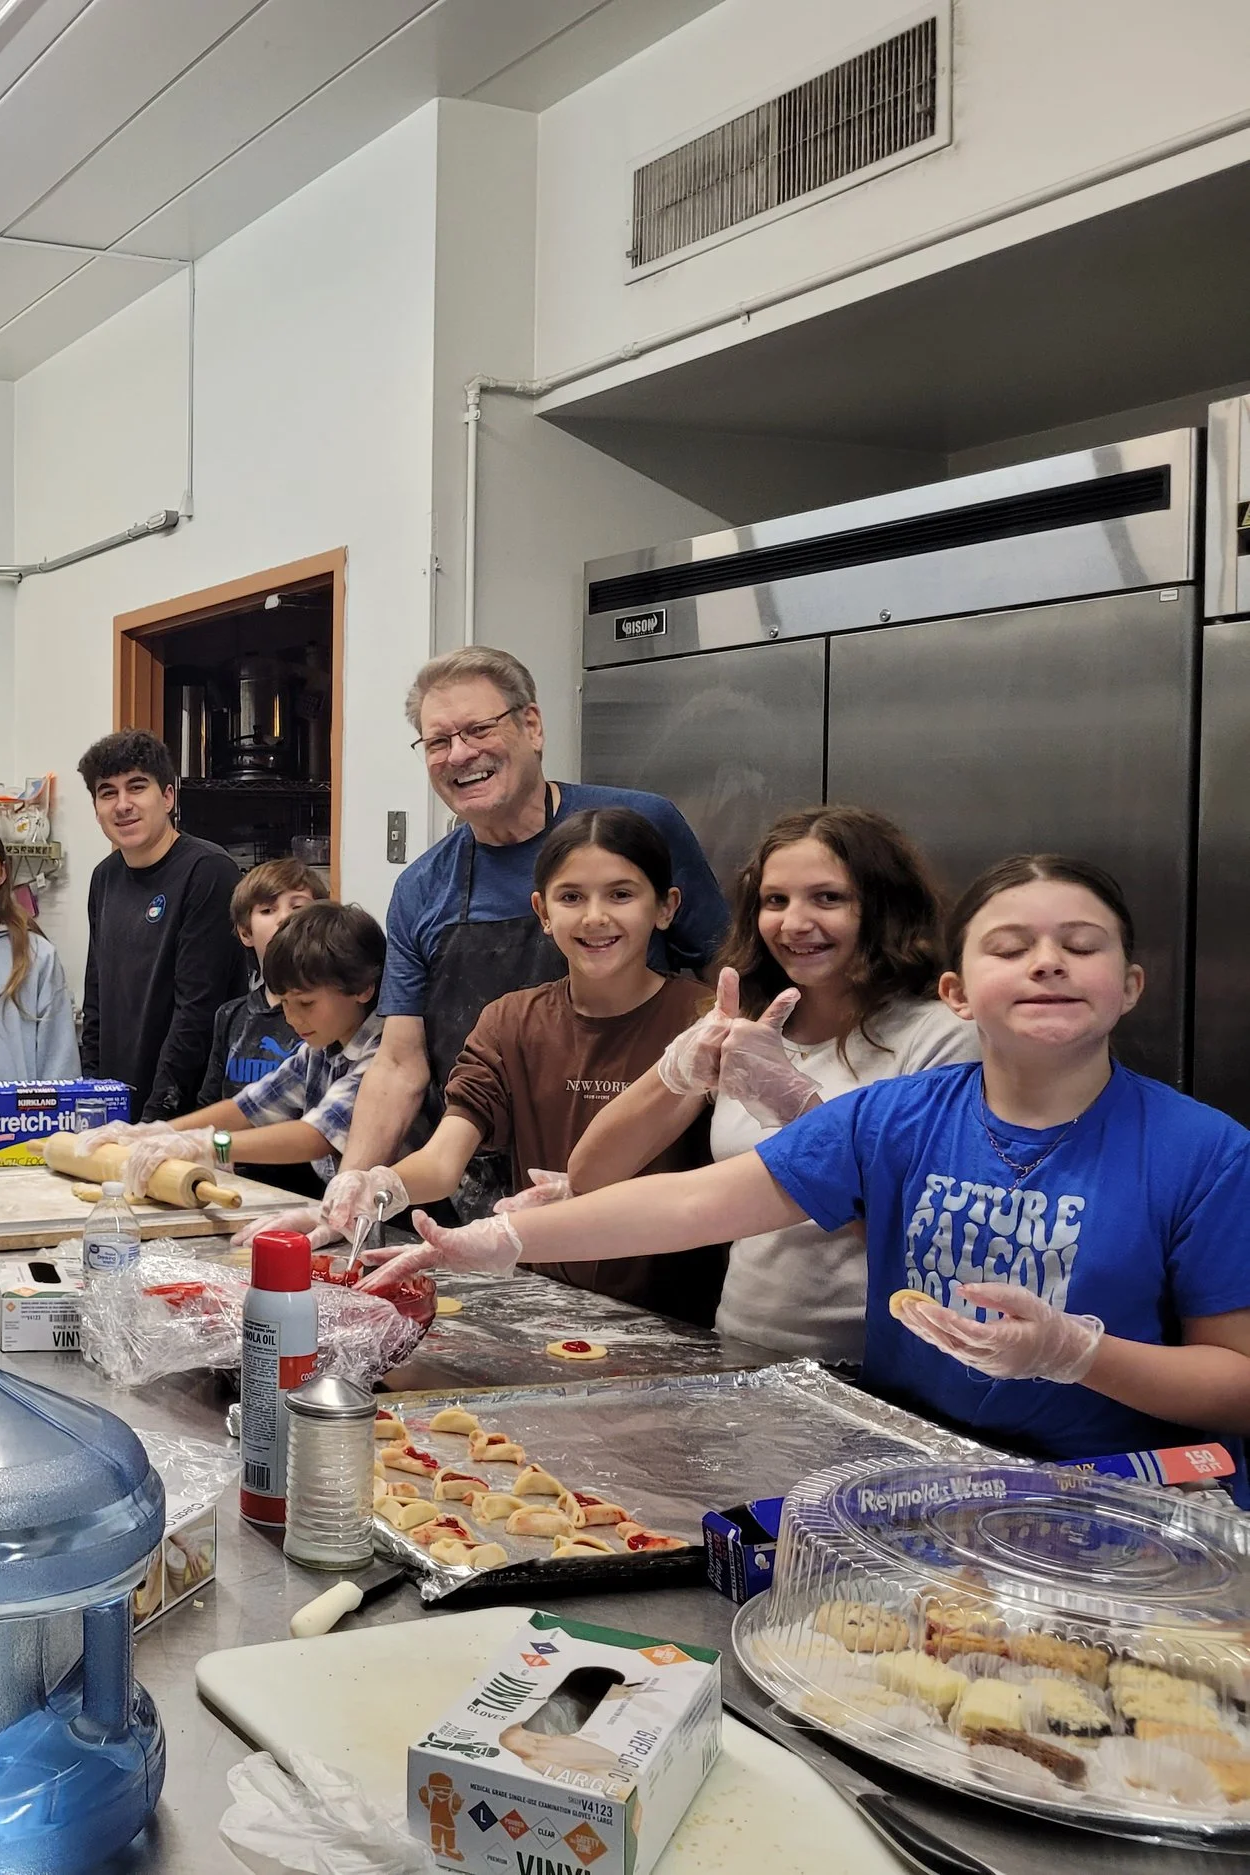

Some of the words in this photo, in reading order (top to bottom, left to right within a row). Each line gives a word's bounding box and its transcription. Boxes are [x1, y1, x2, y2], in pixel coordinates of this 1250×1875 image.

[625, 618, 655, 635] BISON
[566, 1079, 594, 1092] NEW
[594, 1080, 631, 1093] YORK
[17, 1098, 57, 1107] KIRKLAND
[915, 1173, 1086, 1251] FUTURE
[905, 1207, 1078, 1313] FALCON
[262, 1334, 277, 1346] OIL
[1184, 1449, 1216, 1466] 150
[1193, 1462, 1208, 1474] SQ
[1208, 1460, 1223, 1471] FT
[860, 1481, 949, 1516] Reynolds
[950, 1475, 1009, 1499] Wrap
[170, 1502, 205, 1520] Clean
[466, 1704, 508, 1722] GLOVES
[543, 1764, 624, 1798] LARGE
[470, 1782, 491, 1794] MEDICAL
[492, 1788, 508, 1799] GRADE
[508, 1792, 537, 1806] SINGLE-USE
[538, 1800, 571, 1815] EXAMINATION
[572, 1809, 591, 1820] GLOVES
[596, 1816, 614, 1826] LARGE
[581, 1799, 613, 1818] V4123
[479, 1808, 487, 1824] L
[537, 1827, 556, 1839] CLEAR
[576, 1833, 600, 1848] SAFETY
[486, 1854, 508, 1866] PREMIUM
